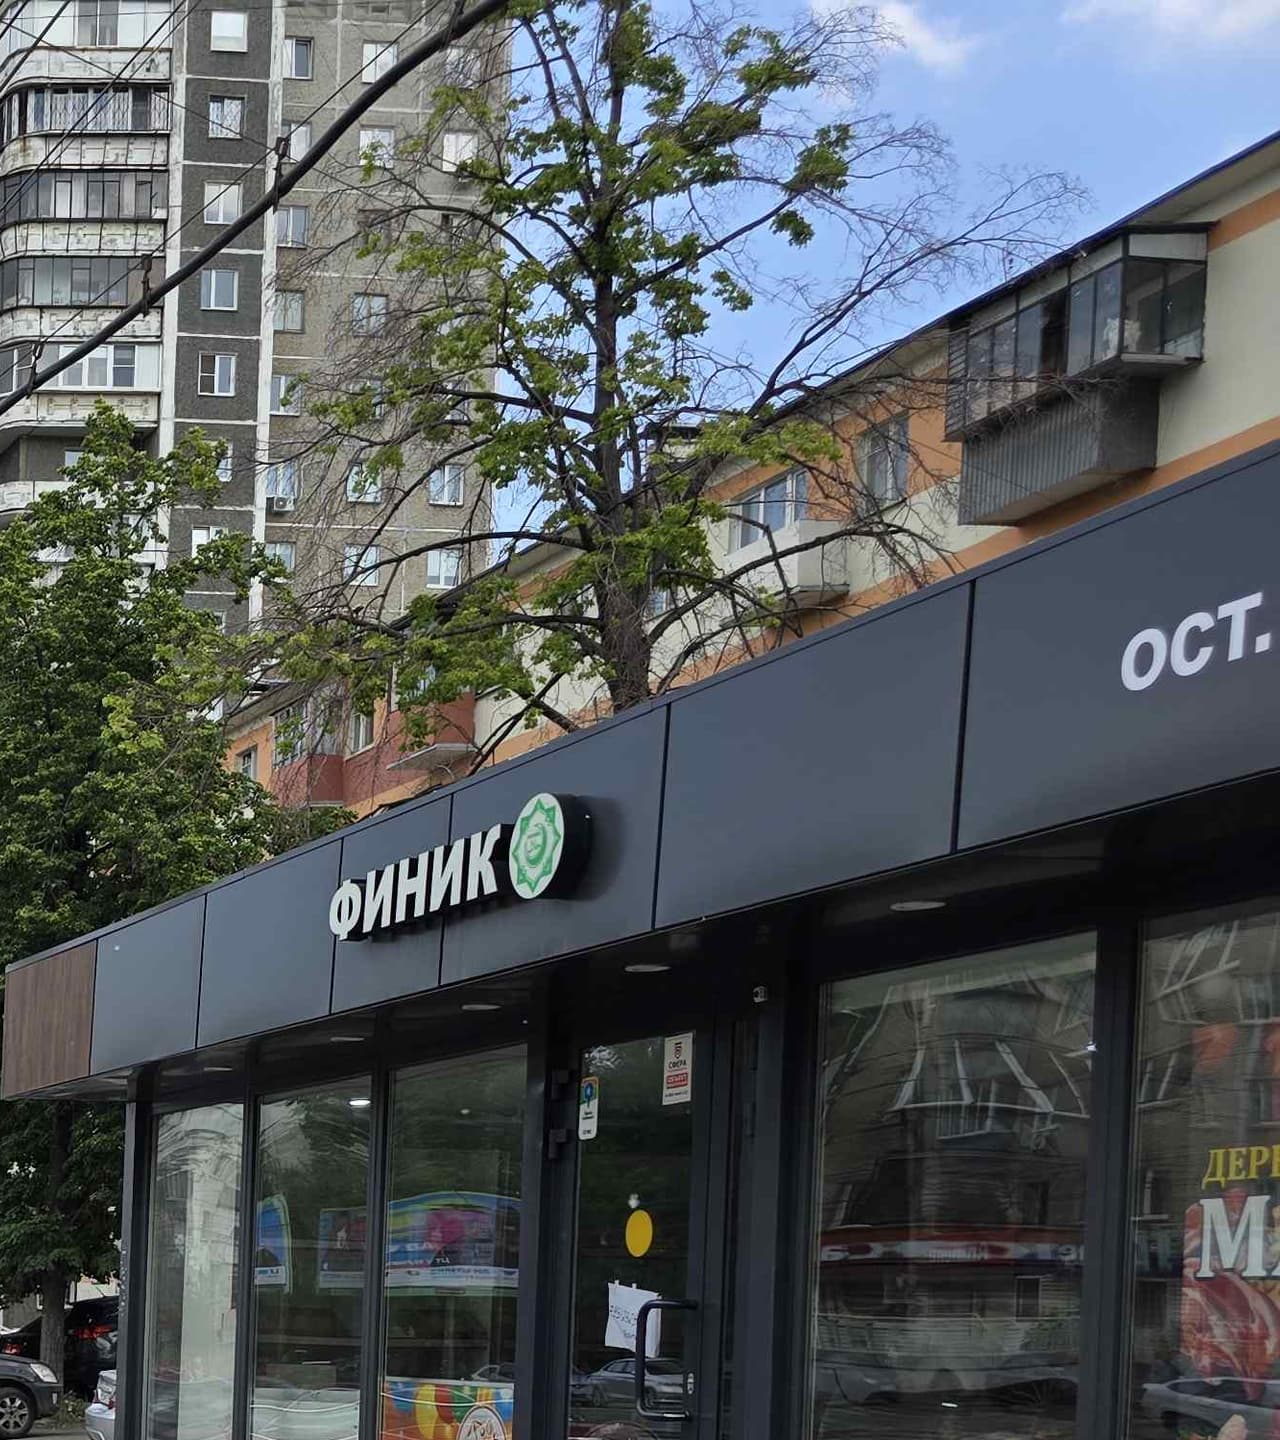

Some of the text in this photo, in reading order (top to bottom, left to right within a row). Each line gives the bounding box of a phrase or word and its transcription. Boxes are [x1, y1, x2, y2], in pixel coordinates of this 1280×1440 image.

[1121, 591, 1271, 691] ОСТ.
[328, 823, 502, 941] ФИНИК
[1195, 1195, 1280, 1278] М
